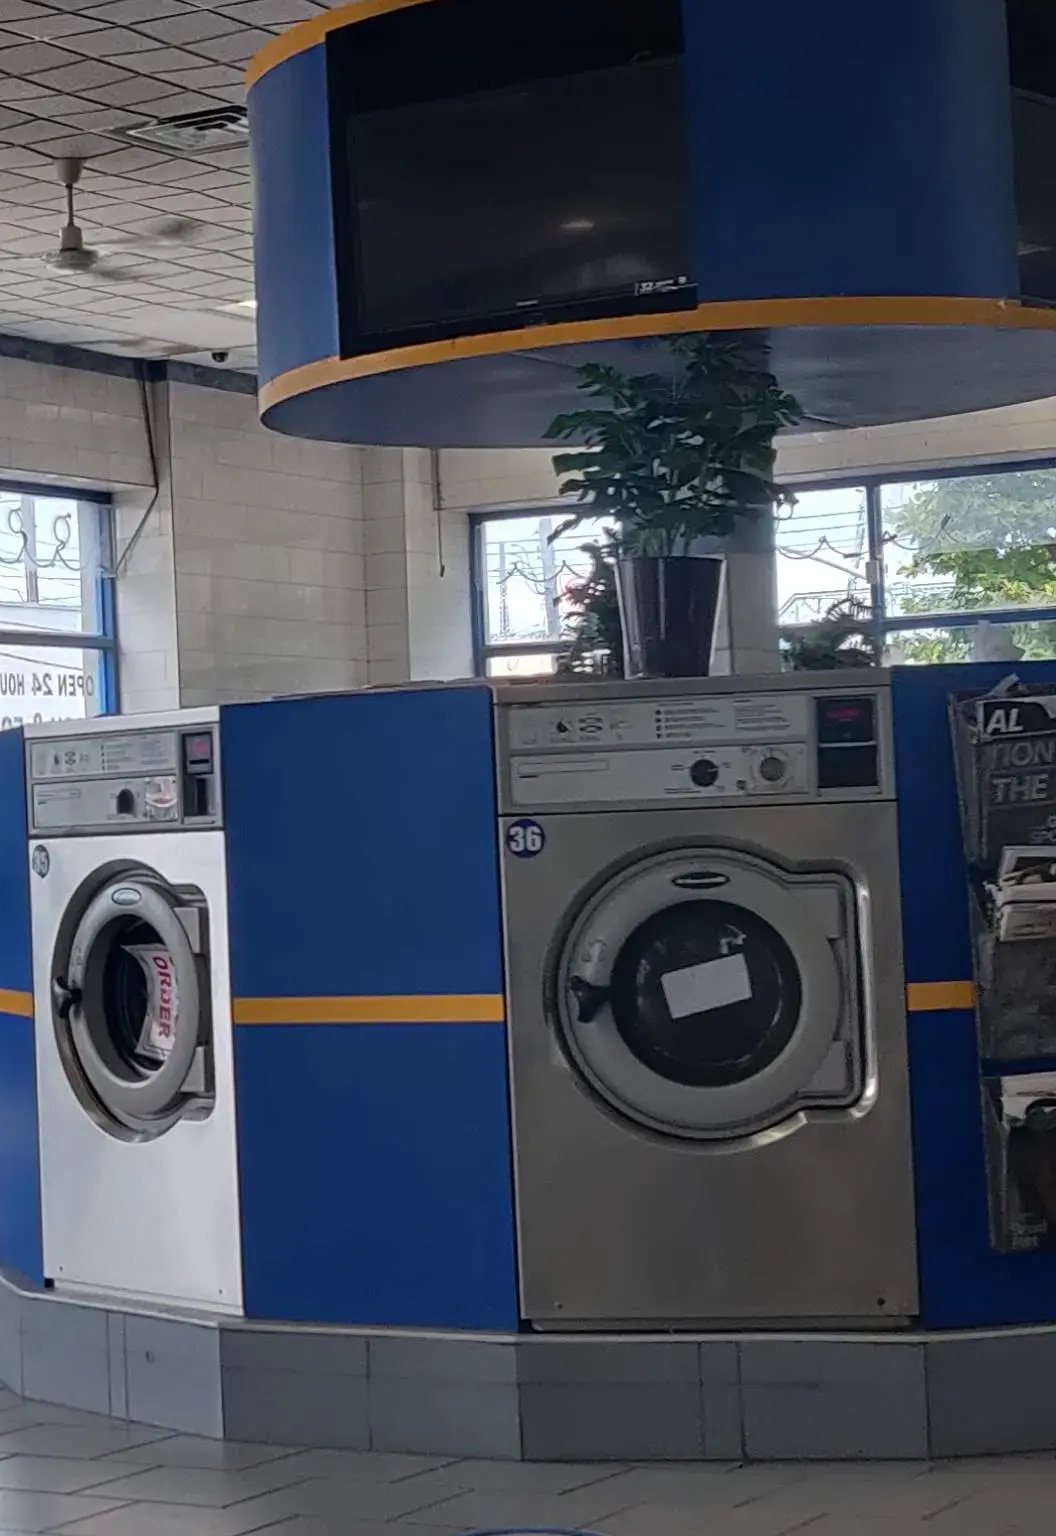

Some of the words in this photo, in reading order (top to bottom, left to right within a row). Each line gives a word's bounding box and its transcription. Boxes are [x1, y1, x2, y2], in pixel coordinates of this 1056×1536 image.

[991, 773, 1049, 803] THE
[509, 826, 542, 852] 36
[152, 956, 172, 1038] ORDER
